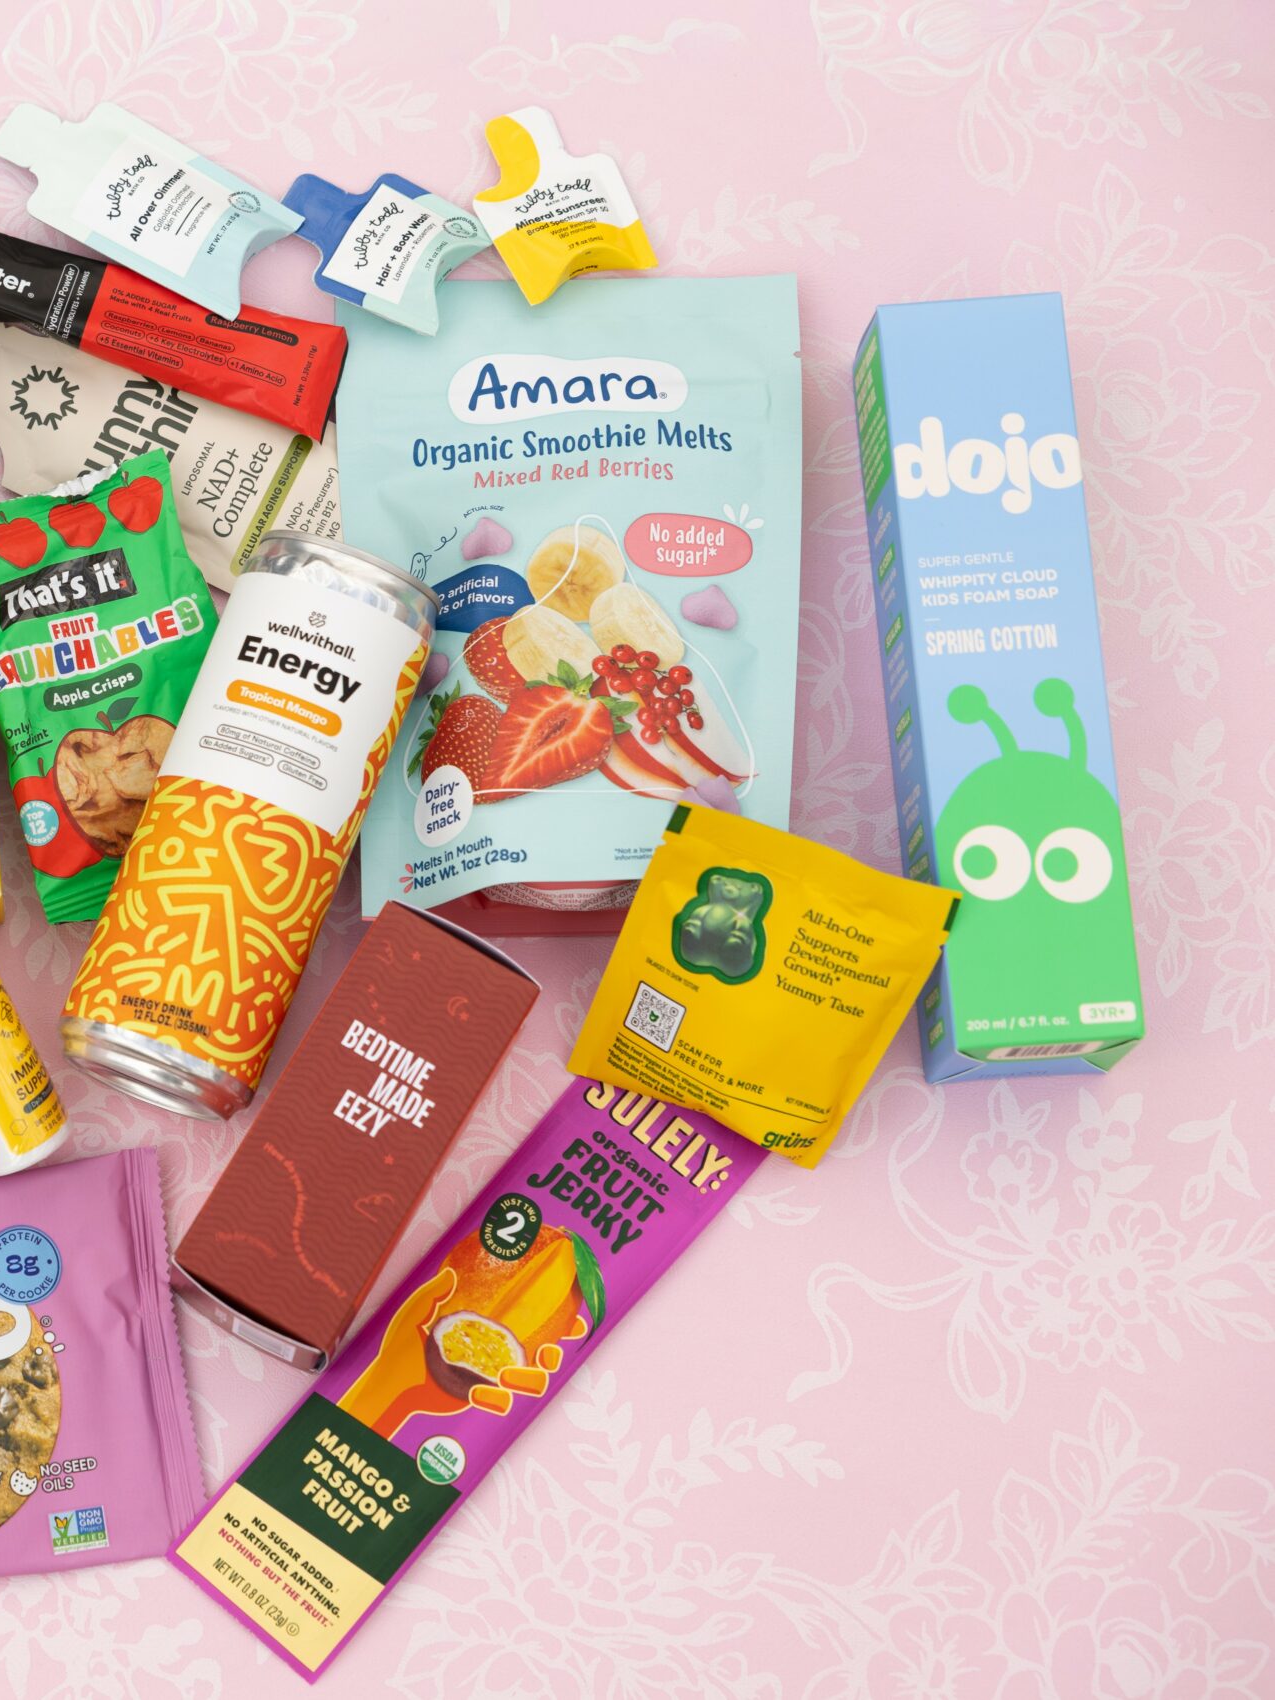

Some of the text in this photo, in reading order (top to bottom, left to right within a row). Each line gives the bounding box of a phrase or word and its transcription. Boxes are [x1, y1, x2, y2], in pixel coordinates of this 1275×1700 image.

[138, 168, 186, 227] Over Ointment
[516, 196, 607, 231] Mineral Sunscreen
[376, 213, 431, 287] Hair Body Wash
[59, 267, 75, 296] Powder
[107, 312, 155, 330] Raspberries
[111, 340, 181, 367] Essential Vitamins
[176, 343, 224, 364] Electrolytes
[240, 364, 283, 384] Amino Acid
[468, 363, 659, 411] Amara
[413, 419, 733, 470] Organic Smoothie Melts
[893, 412, 1083, 514] dojo
[181, 439, 215, 496] LIPOSOMAL
[197, 447, 239, 512] NAD+
[474, 457, 674, 489] Mixed Red Berries
[213, 442, 273, 538] Complete
[239, 443, 304, 566] CELLULAR AGING SUPPORT
[649, 523, 725, 548] No added
[3, 571, 87, 619] That's
[447, 576, 499, 599] artificial
[467, 591, 515, 605] flavors
[919, 569, 1058, 590] WHIPPITY CLOUD
[922, 586, 1059, 607] KIDS FOAM SOAP
[51, 616, 95, 640] FRUIT
[268, 621, 353, 660] wellwithall
[926, 625, 1058, 656] SPRING COTTON
[52, 671, 134, 707] Apple Crisps
[237, 634, 362, 703] Energy
[240, 686, 328, 726] Tropical Mango
[29, 820, 47, 835] 12
[426, 810, 461, 835] snack
[795, 927, 860, 963] Supports
[802, 909, 875, 947] All-In-One
[788, 941, 891, 989] Developmental
[121, 995, 193, 1019] ENERGY DRINK
[775, 975, 865, 1018] Yummy Taste
[341, 1019, 436, 1091] BEDTIME
[677, 1039, 702, 1057] SCAN
[673, 1050, 765, 1095] FREE MORE
[333, 1089, 393, 1138] EEZY
[367, 1071, 436, 1129] MADE
[562, 1139, 666, 1220] FRUIT
[592, 1131, 670, 1196] organic
[497, 1211, 525, 1244] 2
[527, 1163, 643, 1255] JERKY
[315, 1427, 397, 1499] MANGO
[301, 1478, 364, 1535] FRUIT
[303, 1448, 394, 1530] PASSION
[218, 1528, 282, 1584] NOTHING BUT
[268, 1530, 301, 1562] SUGAR
[241, 1528, 340, 1618] ARTIFICIAL ANYTHING.
